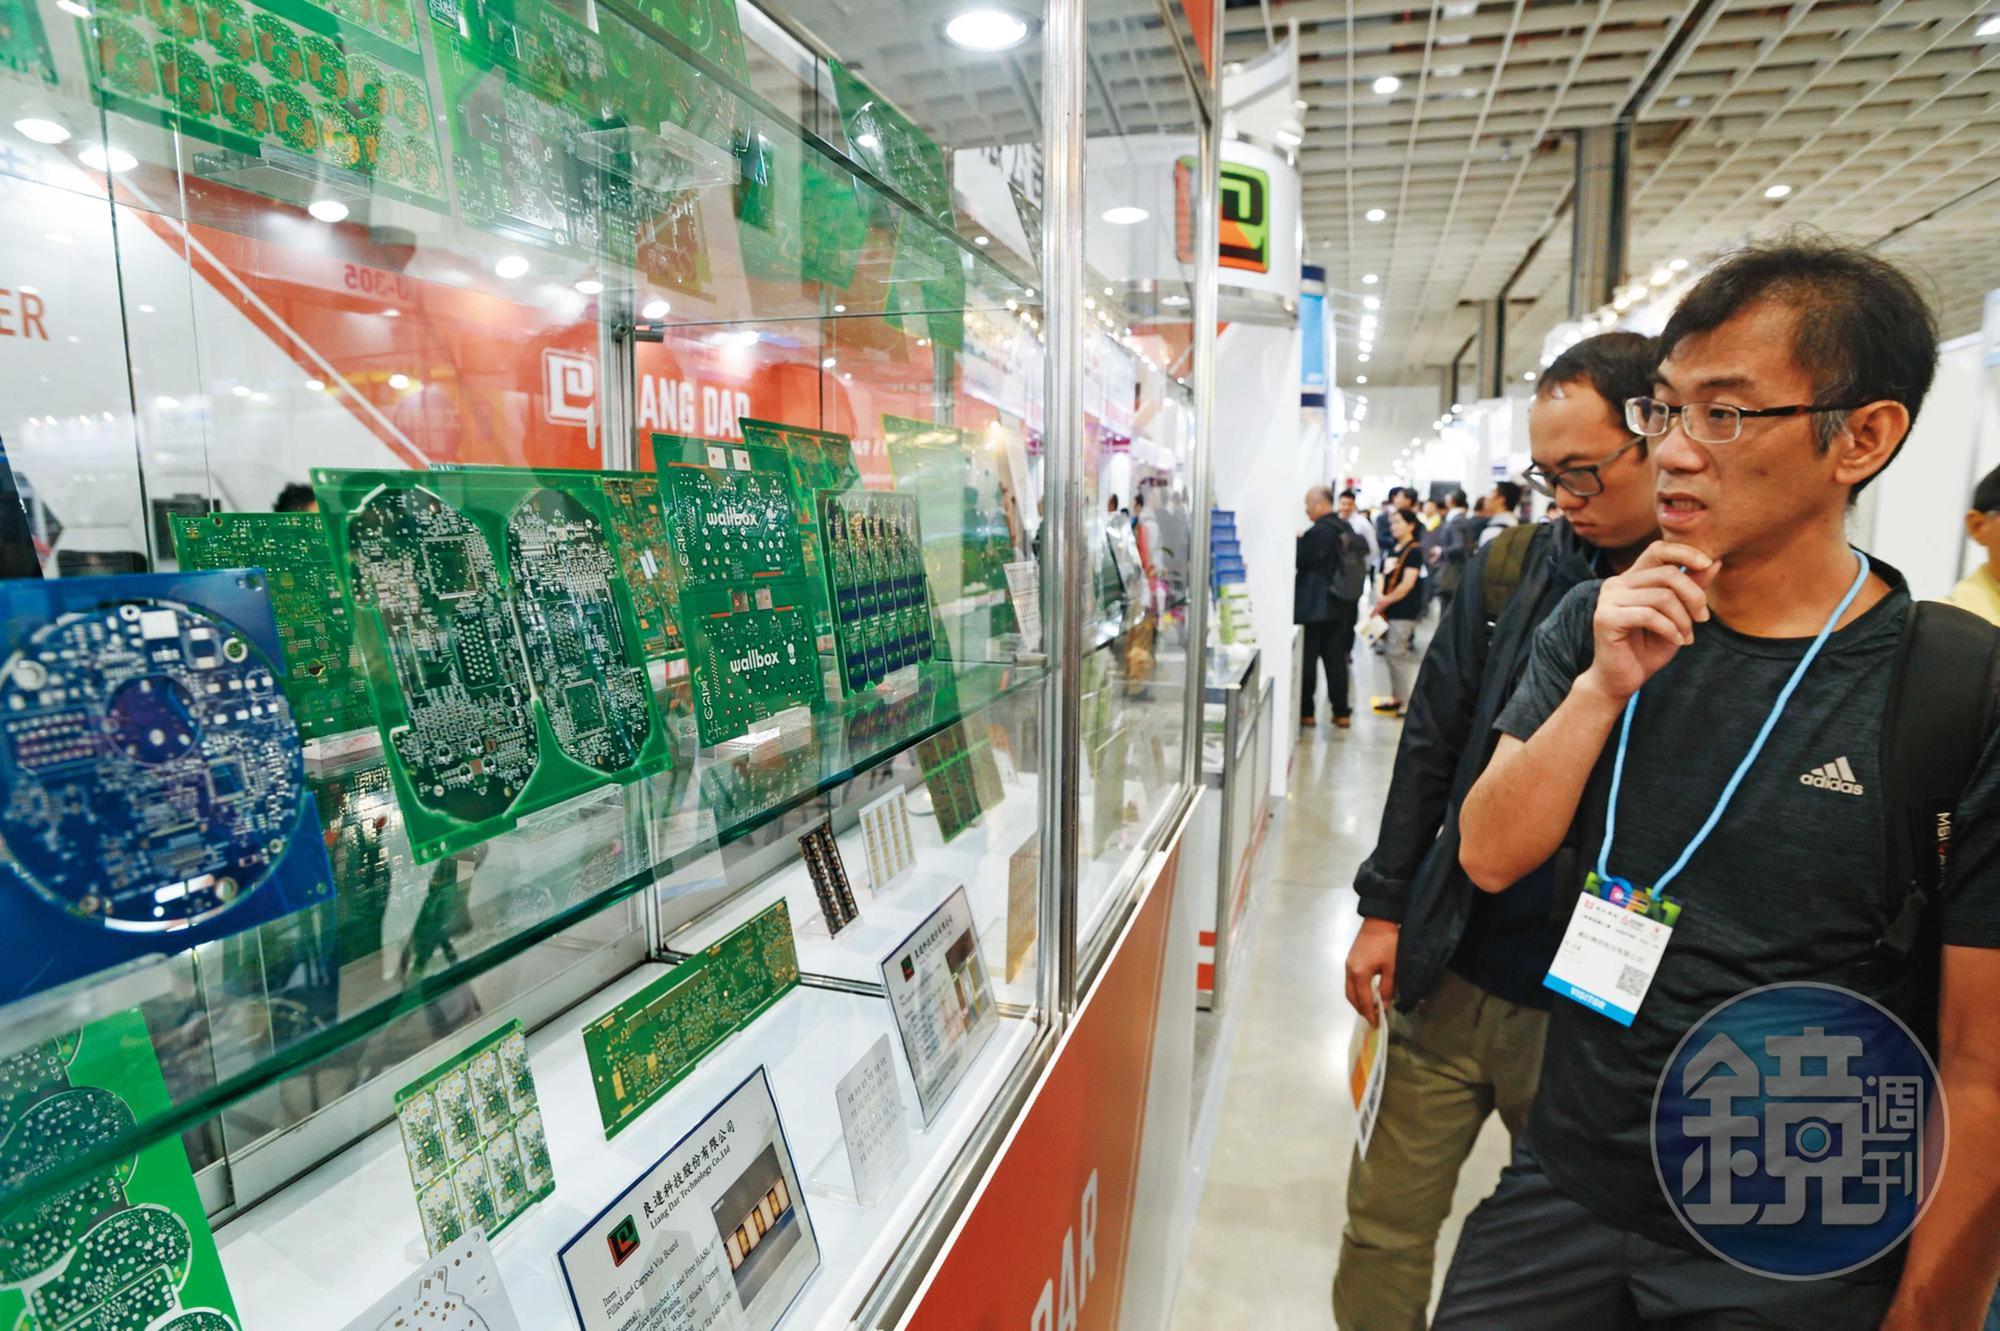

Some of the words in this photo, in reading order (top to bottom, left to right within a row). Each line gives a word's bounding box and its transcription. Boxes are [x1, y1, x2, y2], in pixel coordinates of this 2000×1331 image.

[638, 374, 694, 433] ANG
[706, 505, 758, 528] wallbox
[729, 648, 780, 675] wallbox
[1800, 773, 1864, 796] adidas
[643, 1119, 736, 1218] 良達科技股份有限公司
[649, 1207, 668, 1230] Liang
[668, 1195, 680, 1211] Dar
[680, 1165, 712, 1198] Technology
